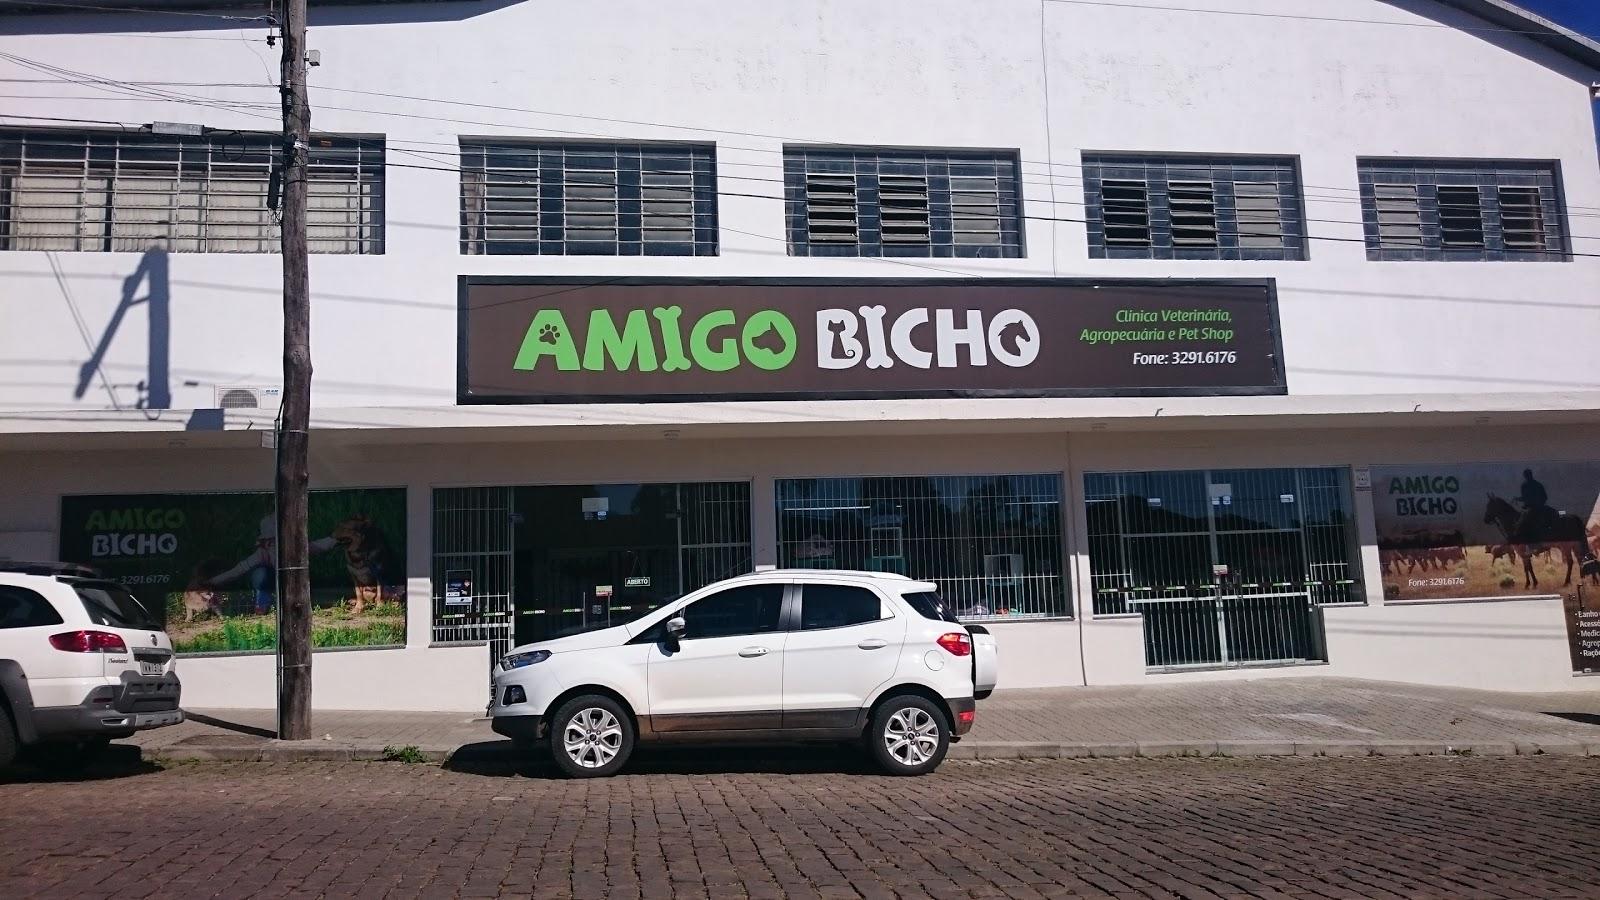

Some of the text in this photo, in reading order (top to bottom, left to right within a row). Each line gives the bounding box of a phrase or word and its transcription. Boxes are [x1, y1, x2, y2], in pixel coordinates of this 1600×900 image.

[1116, 309, 1232, 323] Clínica Veterinária,
[513, 304, 1041, 372] AMIGO BICHO
[1080, 327, 1234, 344] Agropecuária e Pet Shop
[1133, 351, 1237, 365] Fone: 3291.6176
[1389, 475, 1460, 495] AMIGO
[1396, 497, 1458, 516] BICHO
[85, 508, 184, 530] AMIGO
[92, 533, 178, 556] BICHO
[120, 575, 170, 585] 3291.6176
[1408, 579, 1428, 587] Fone:
[1429, 577, 1465, 586] 3291.6176
[1583, 649, 1600, 657] Raçõ
